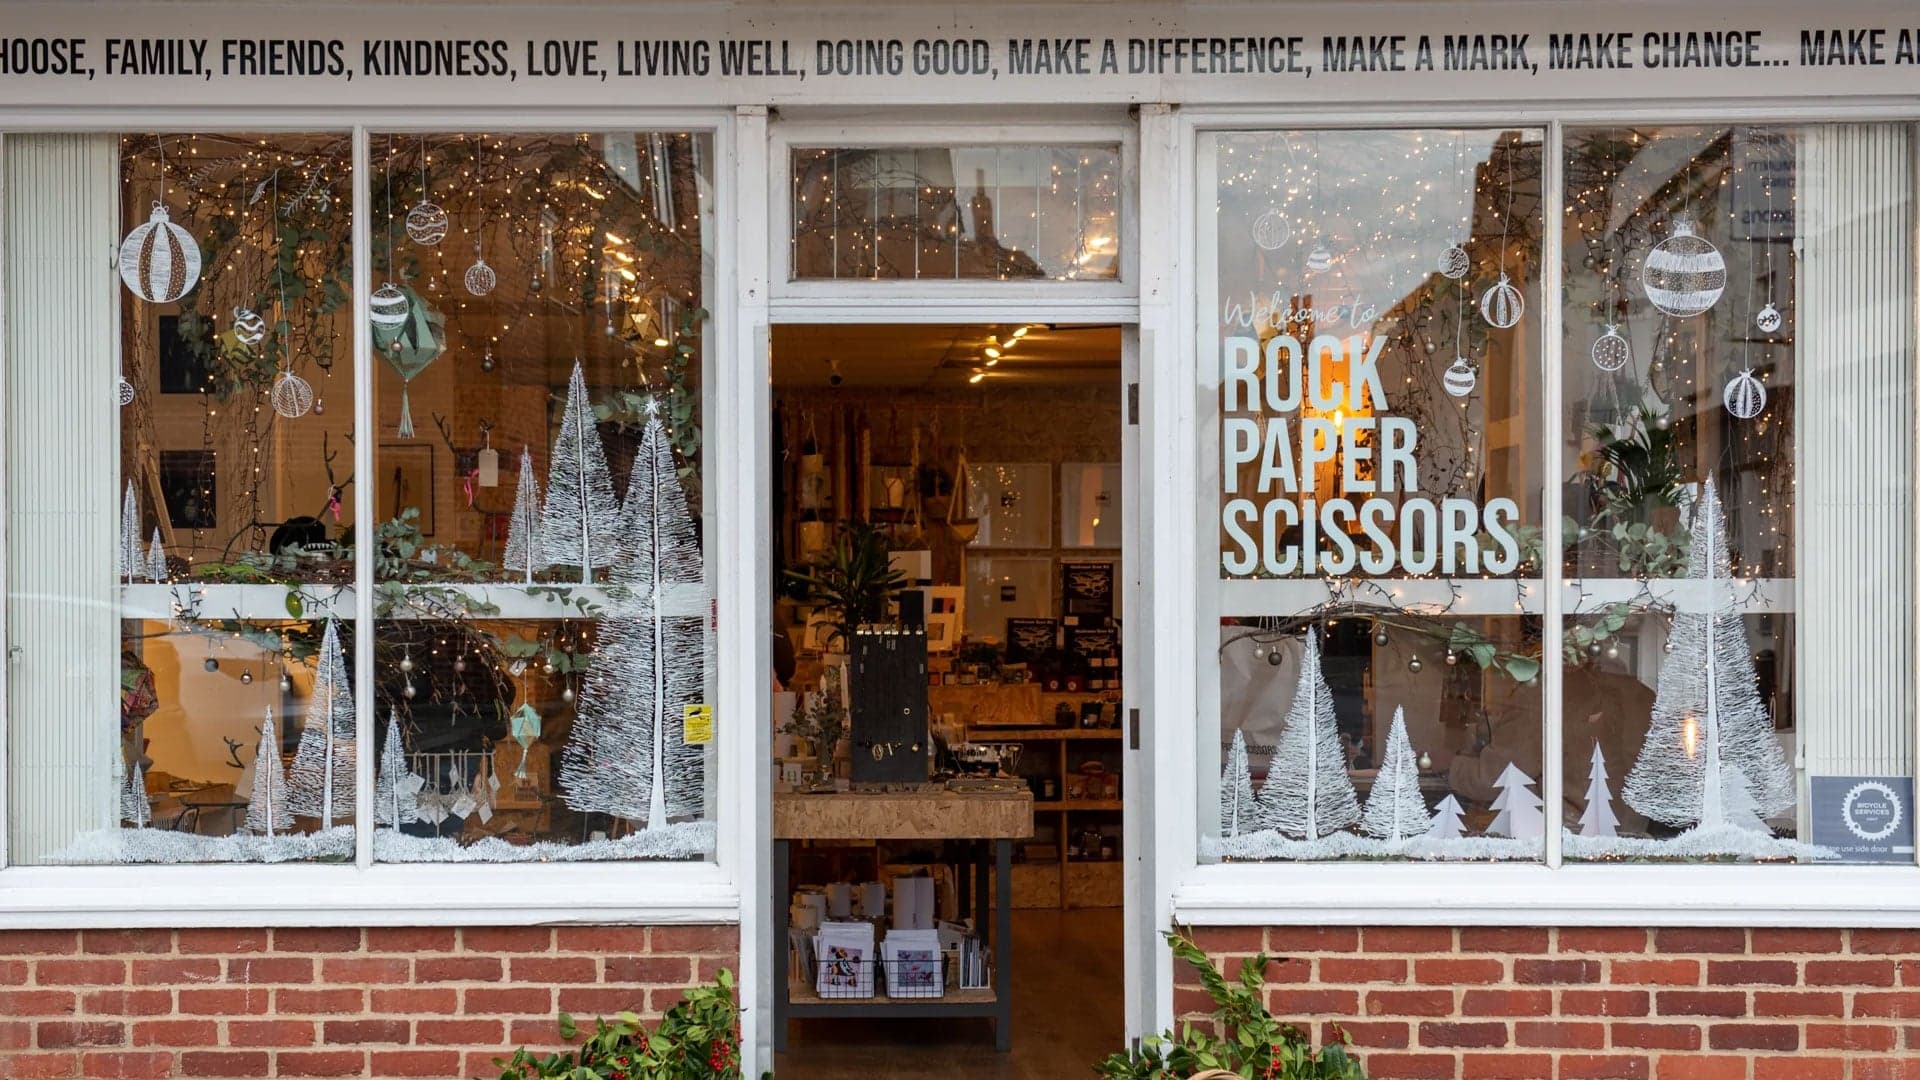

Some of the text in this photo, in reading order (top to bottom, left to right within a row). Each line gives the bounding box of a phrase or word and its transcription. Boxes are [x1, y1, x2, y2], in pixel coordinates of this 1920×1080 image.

[104, 38, 212, 82] FAMILY,
[221, 39, 353, 82] FRIENDS,
[363, 39, 517, 82] KINDNESS,
[527, 39, 607, 82] LOVE,
[617, 39, 710, 77] LIVING
[718, 39, 806, 82] WELL,
[816, 39, 904, 76] DOING
[912, 38, 998, 81] GOOD,
[1008, 38, 1092, 74] MAKE
[1100, 38, 1119, 74] A
[1128, 36, 1312, 79] DIFFERENCE,
[1322, 35, 1407, 72] MAKE
[1414, 34, 1434, 72] A
[1443, 33, 1538, 76] MARK,
[1548, 32, 1634, 70] MAKE
[1642, 30, 1790, 69] CHANGE...
[1800, 28, 1887, 66] MAKE
[1894, 28, 1920, 65] A
[1224, 290, 1344, 328] Welcome
[1223, 335, 1389, 412] ROCK
[1223, 417, 1419, 493] PAPER
[1222, 498, 1520, 575] SCISSORS
